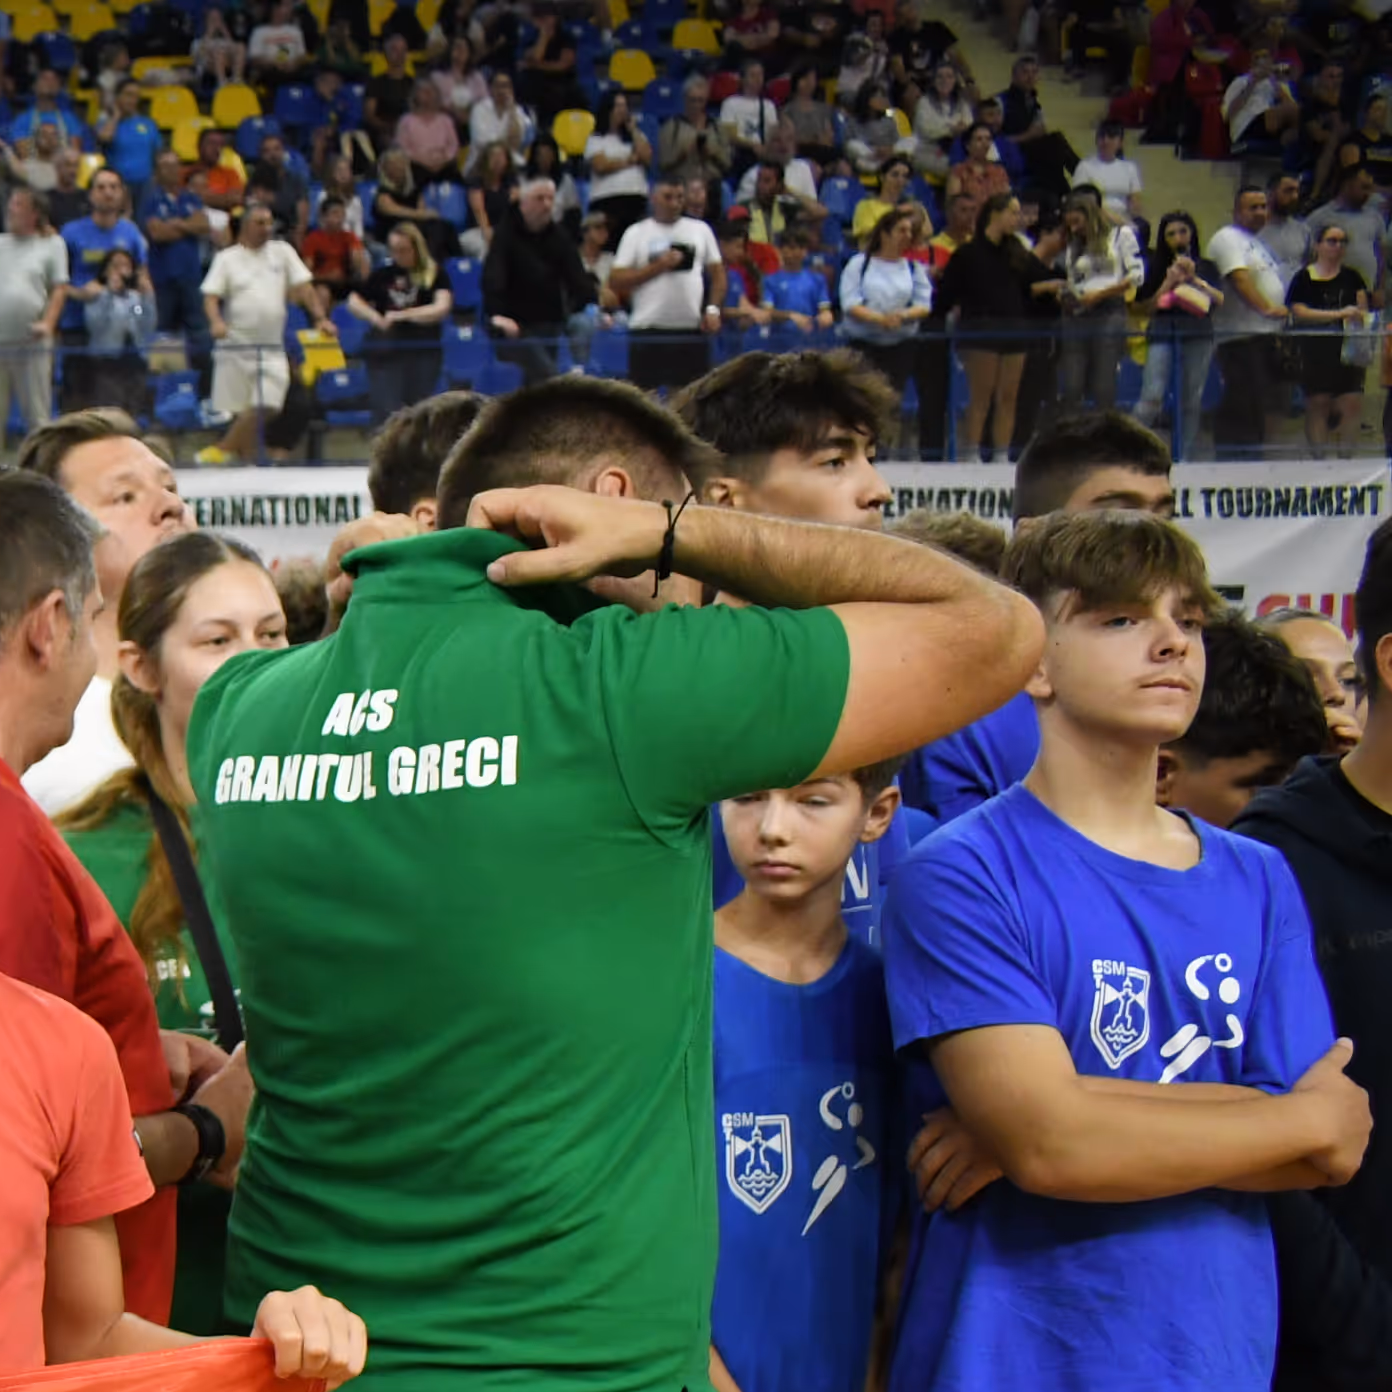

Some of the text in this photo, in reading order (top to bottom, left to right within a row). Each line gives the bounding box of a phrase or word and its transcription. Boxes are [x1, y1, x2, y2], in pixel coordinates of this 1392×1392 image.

[1201, 484, 1383, 519] TOURNAMENT
[321, 688, 399, 737] ACS
[214, 735, 519, 806] GRANITUL GRECI
[1092, 959, 1126, 977] CSM
[722, 1112, 755, 1129] CSM
